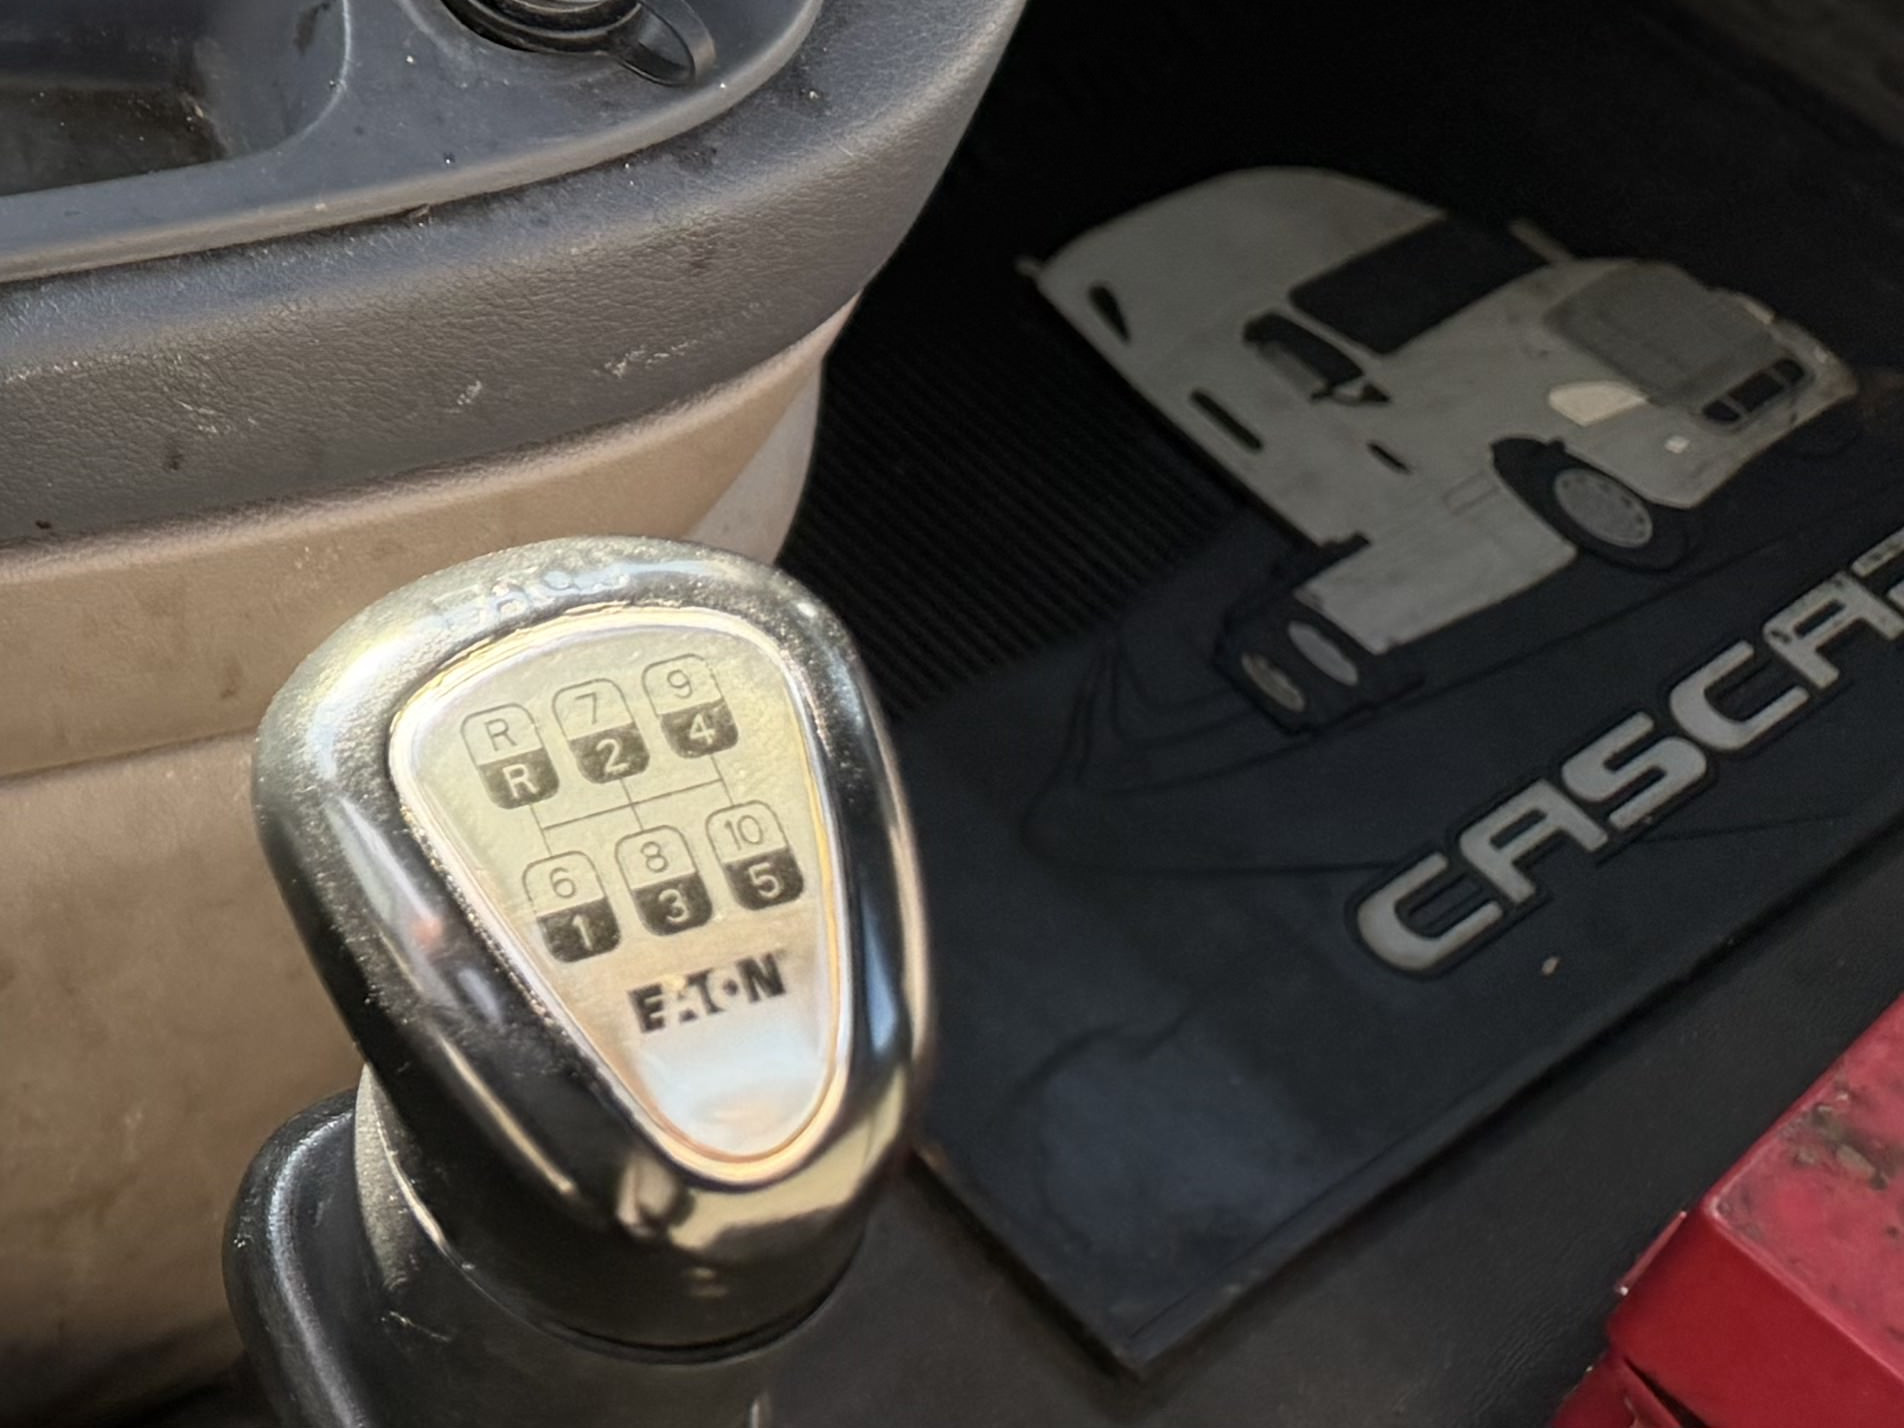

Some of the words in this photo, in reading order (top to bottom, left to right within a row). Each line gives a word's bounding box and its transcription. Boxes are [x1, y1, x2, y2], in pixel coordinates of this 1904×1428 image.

[666, 668, 695, 700] 9
[574, 693, 603, 726] 7
[483, 718, 517, 752] R
[688, 711, 717, 745] 4
[594, 737, 630, 776] 2
[501, 763, 536, 799] R
[723, 814, 766, 850] 10
[639, 841, 669, 874] 8
[548, 866, 577, 900] 6
[747, 863, 782, 899] 5
[658, 888, 692, 924] 3
[570, 913, 595, 949] 1
